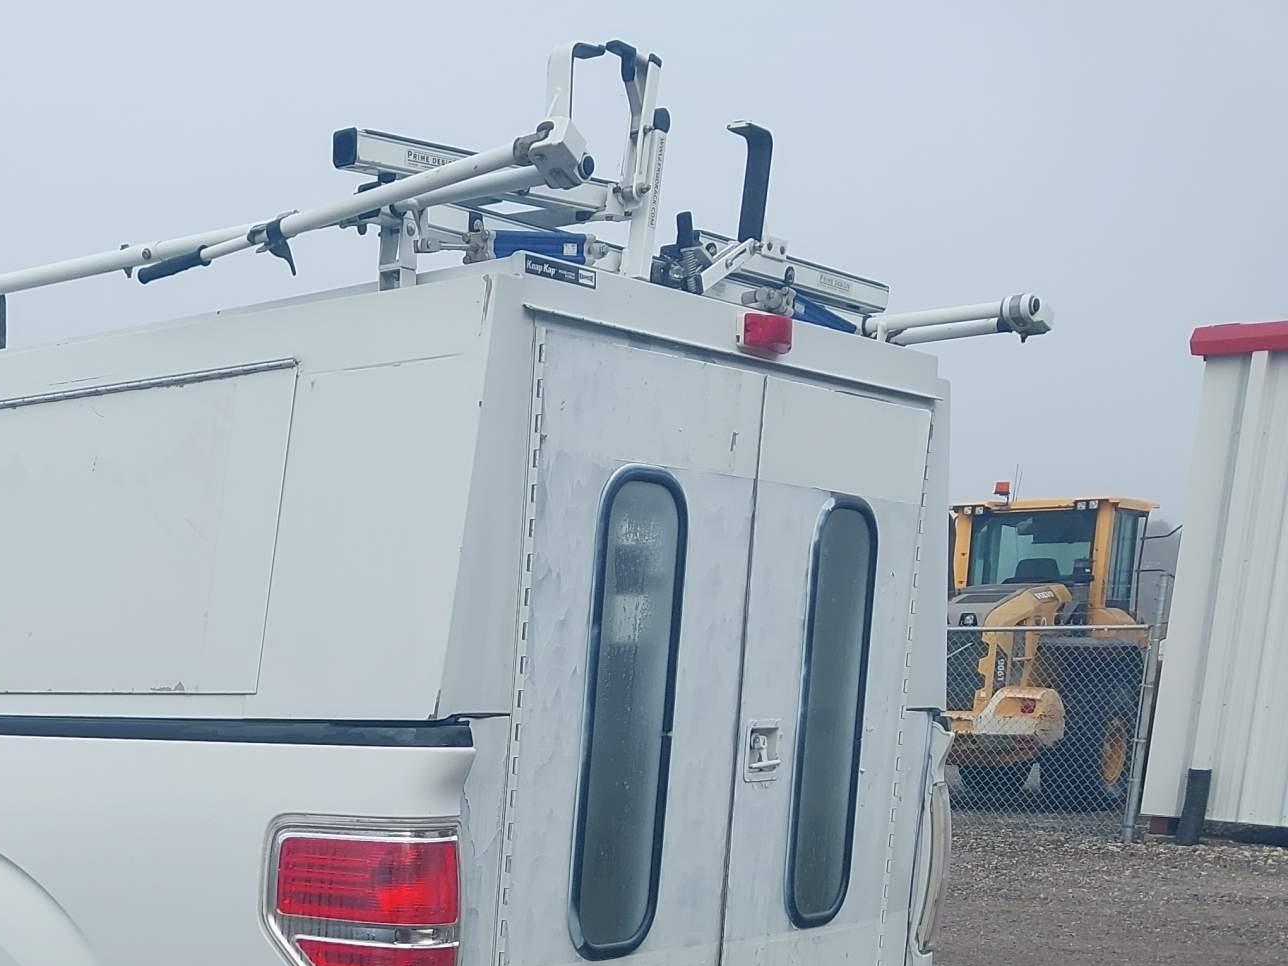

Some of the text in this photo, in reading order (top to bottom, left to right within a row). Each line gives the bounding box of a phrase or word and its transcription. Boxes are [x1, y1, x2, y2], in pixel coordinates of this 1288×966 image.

[407, 150, 430, 163] PRIME
[527, 260, 543, 274] Knap
[544, 263, 556, 276] Kap
